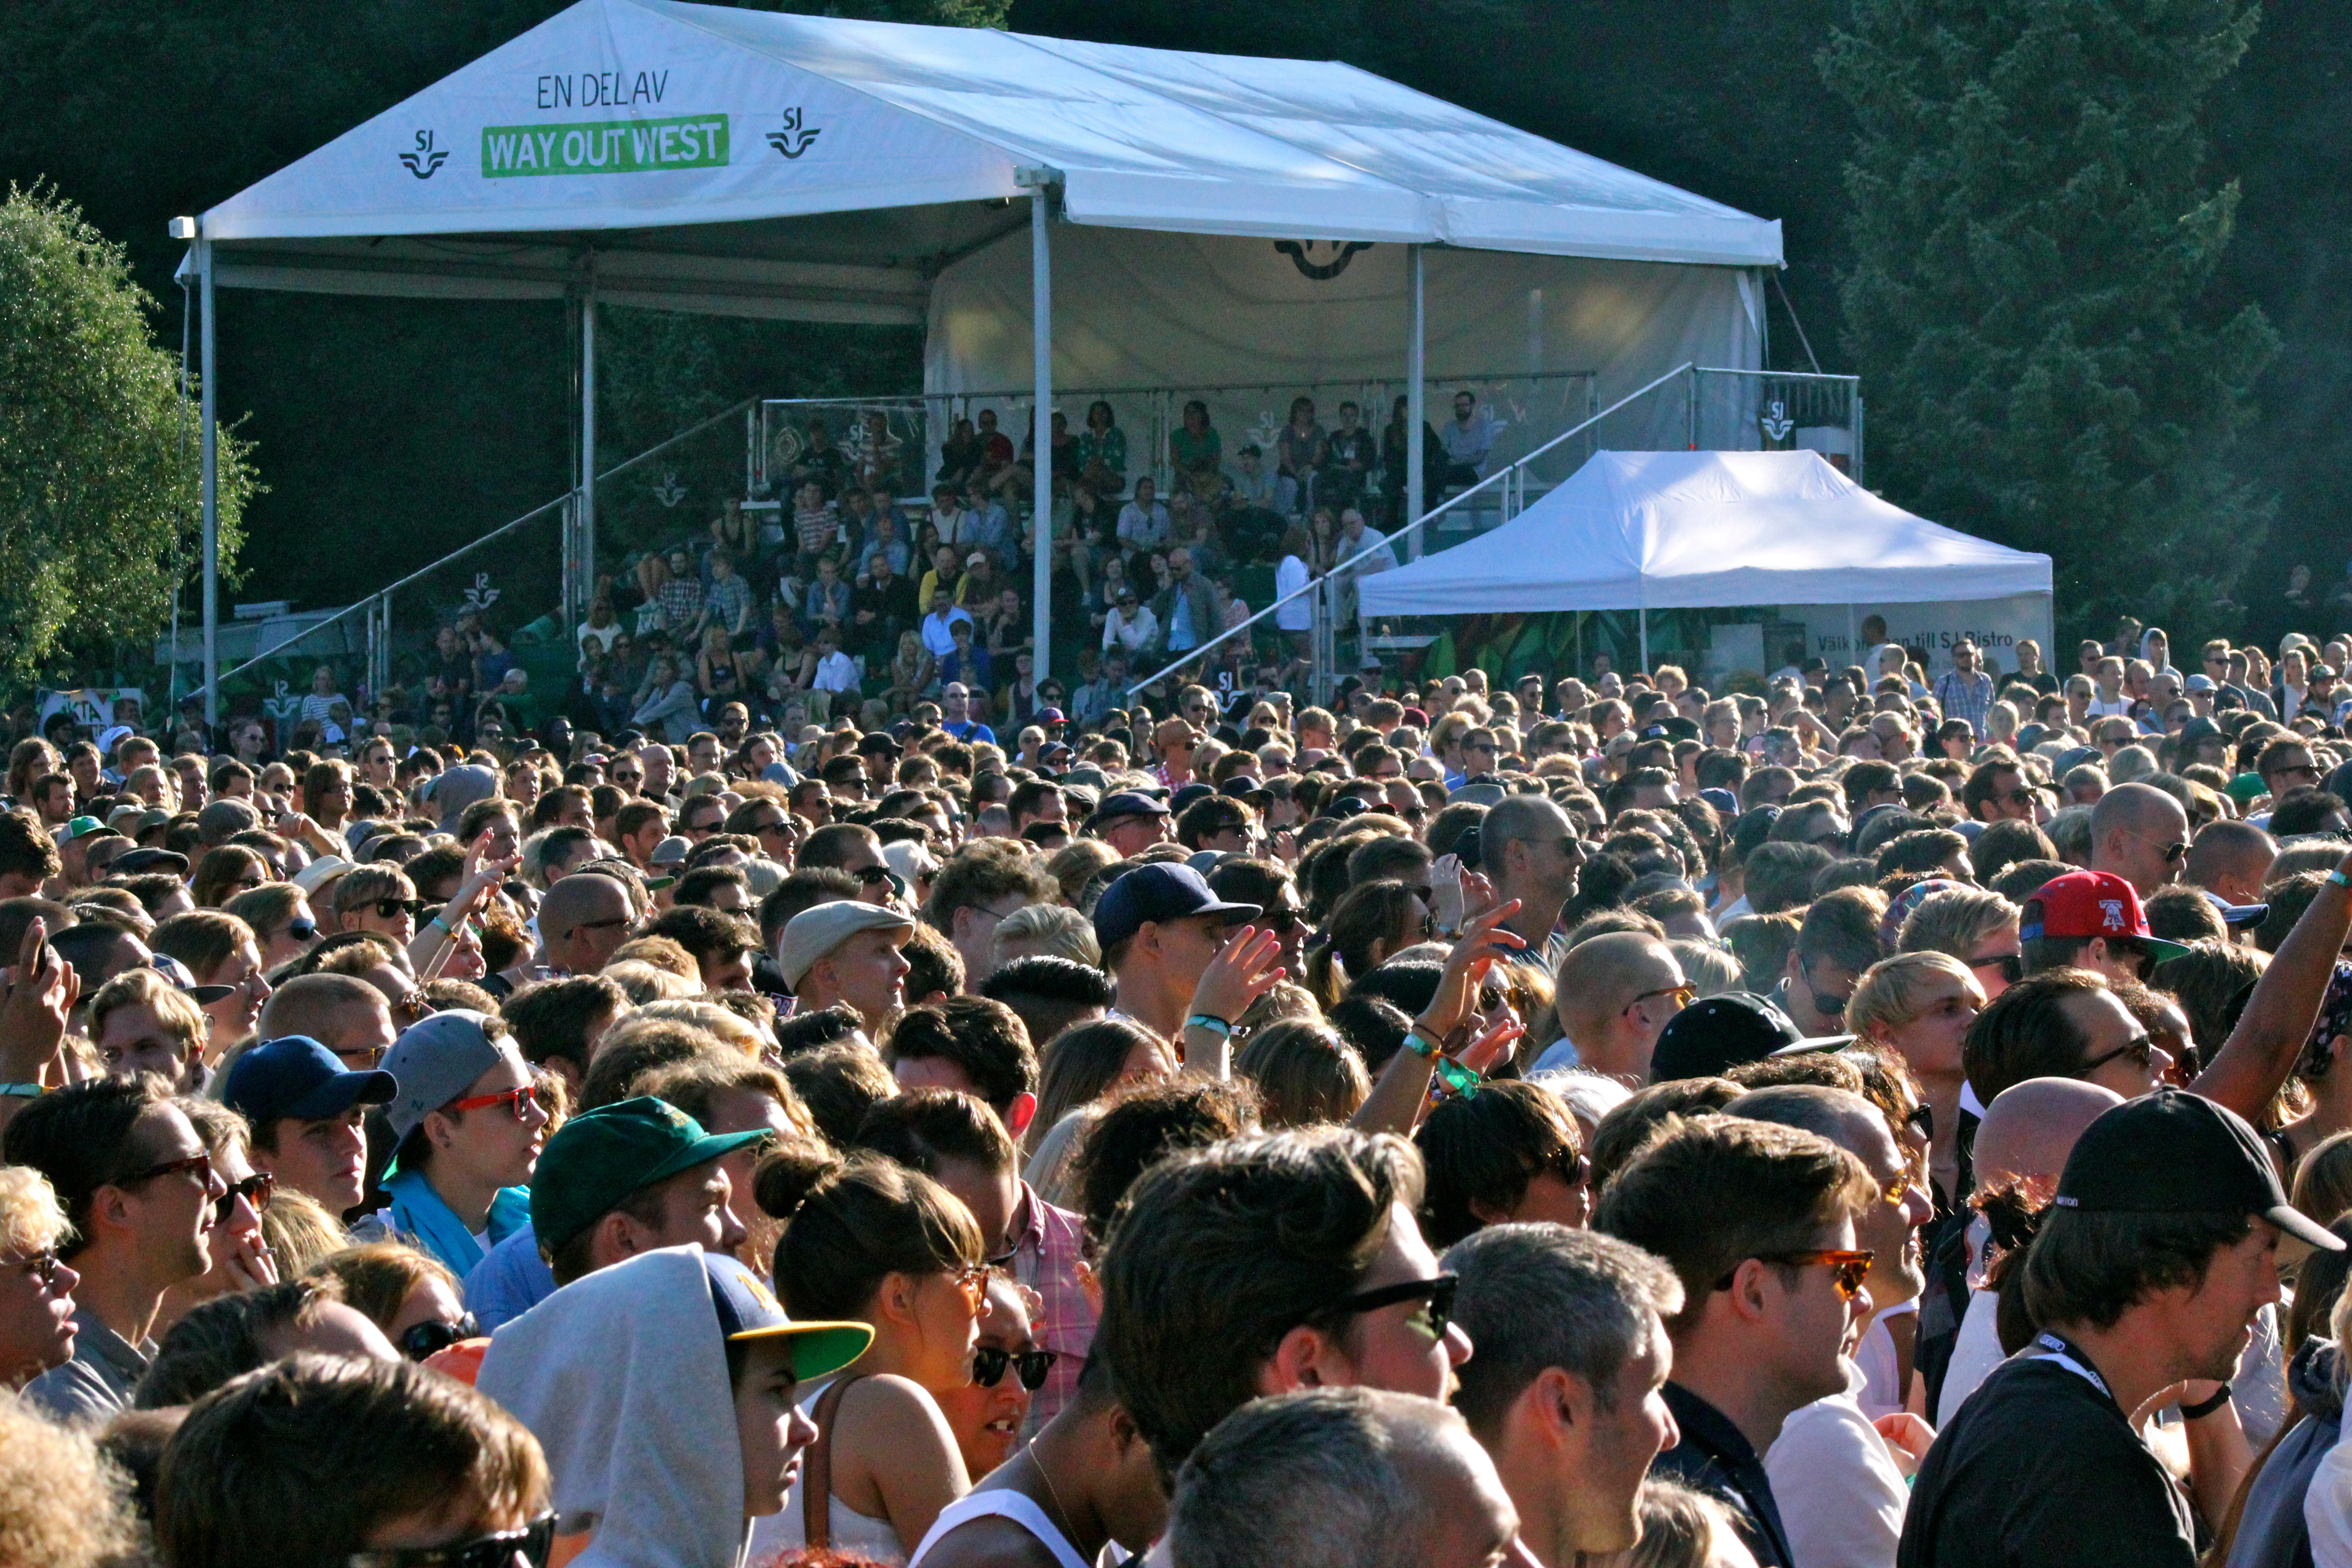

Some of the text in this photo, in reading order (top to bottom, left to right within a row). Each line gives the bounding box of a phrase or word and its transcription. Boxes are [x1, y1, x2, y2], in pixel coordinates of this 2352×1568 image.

[538, 75, 572, 108] EN
[783, 106, 801, 131] SJ
[416, 129, 433, 152] SJ
[488, 122, 722, 170] WAY OUT WEST
[1771, 401, 1784, 420] SJ
[1818, 635, 1910, 652] Välkoen
[1915, 632, 1936, 649] till
[1965, 630, 2013, 647] Bistro
[1218, 672, 1232, 691] SJ
